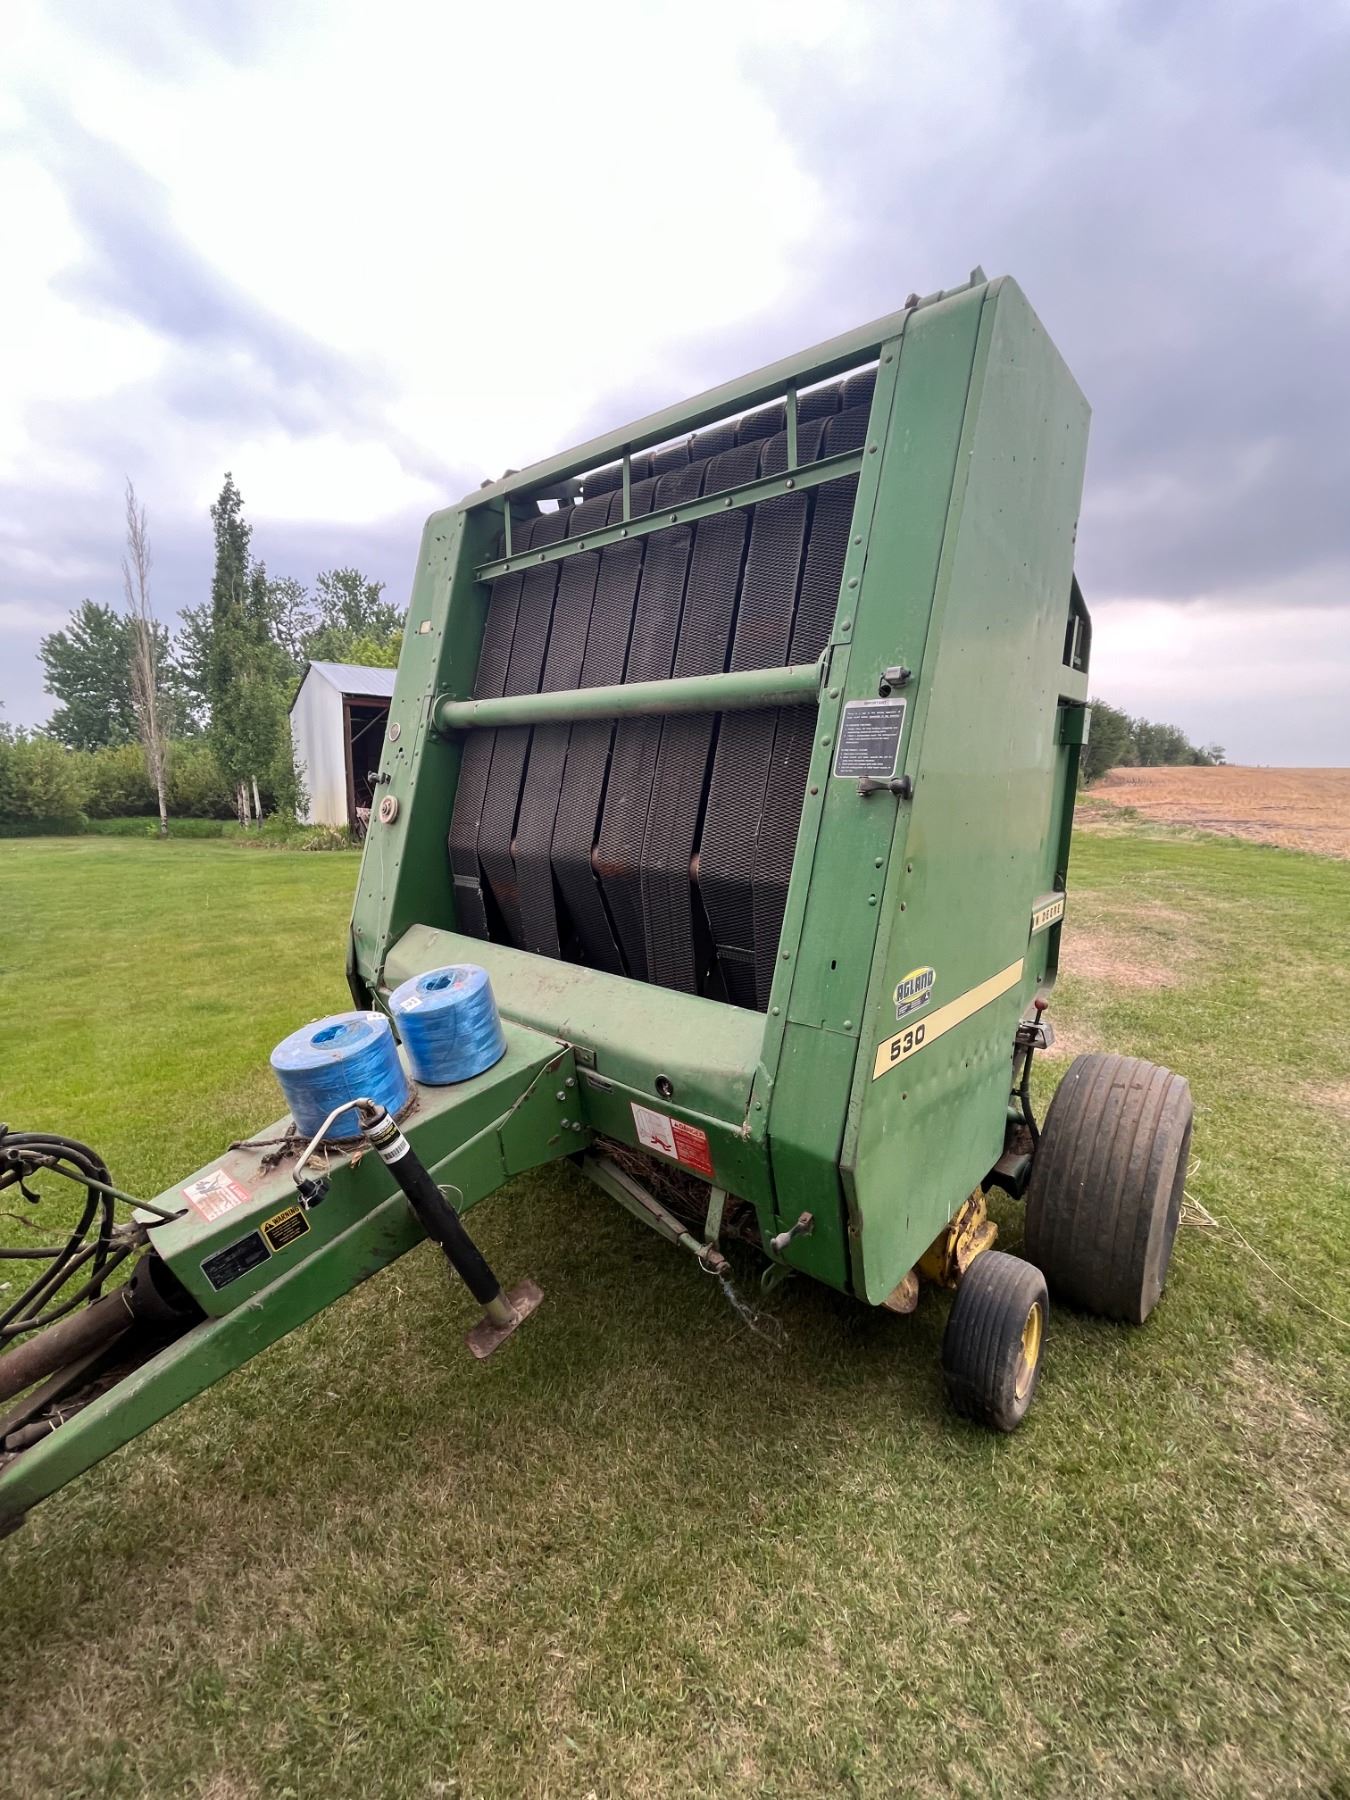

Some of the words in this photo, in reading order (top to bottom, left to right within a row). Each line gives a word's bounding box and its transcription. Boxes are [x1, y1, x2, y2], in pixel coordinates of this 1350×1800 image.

[1042, 903, 1061, 922] DEERE
[897, 970, 934, 1001] AGLAND
[890, 1023, 926, 1062] 530
[272, 1205, 300, 1225] WARNING
